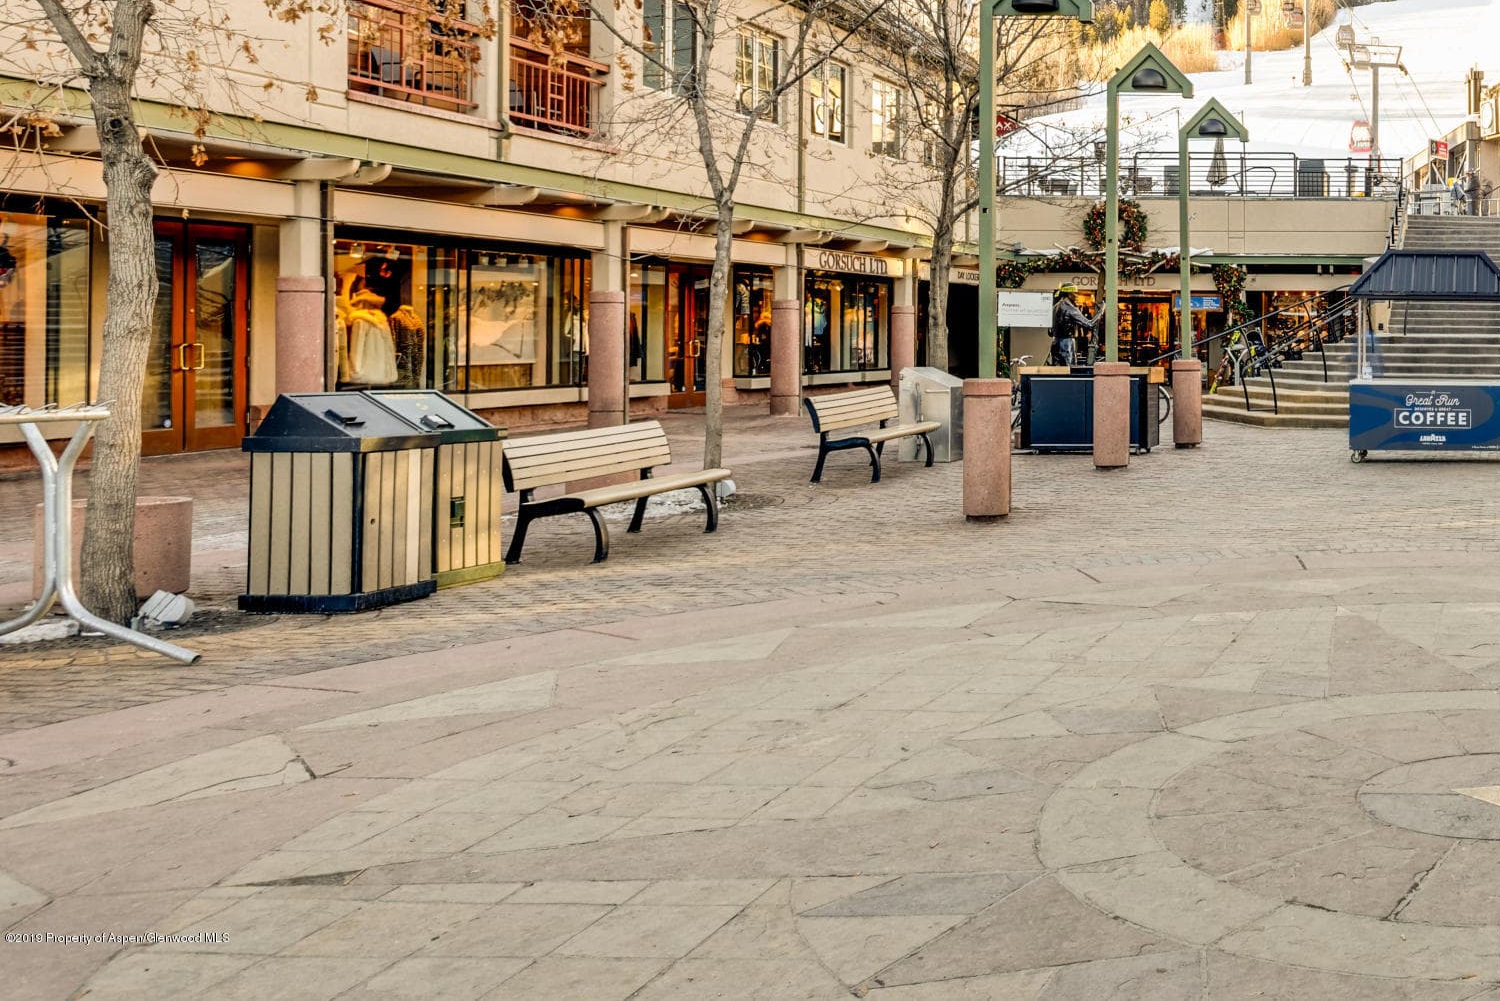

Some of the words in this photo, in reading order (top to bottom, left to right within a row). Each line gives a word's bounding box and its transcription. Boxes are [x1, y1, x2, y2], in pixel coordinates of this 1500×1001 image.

[819, 251, 866, 273] GORSUCH
[1071, 276, 1128, 287] GORH
[1405, 394, 1433, 406] Great
[1434, 394, 1460, 406] Run
[1398, 411, 1467, 425] COFFEE
